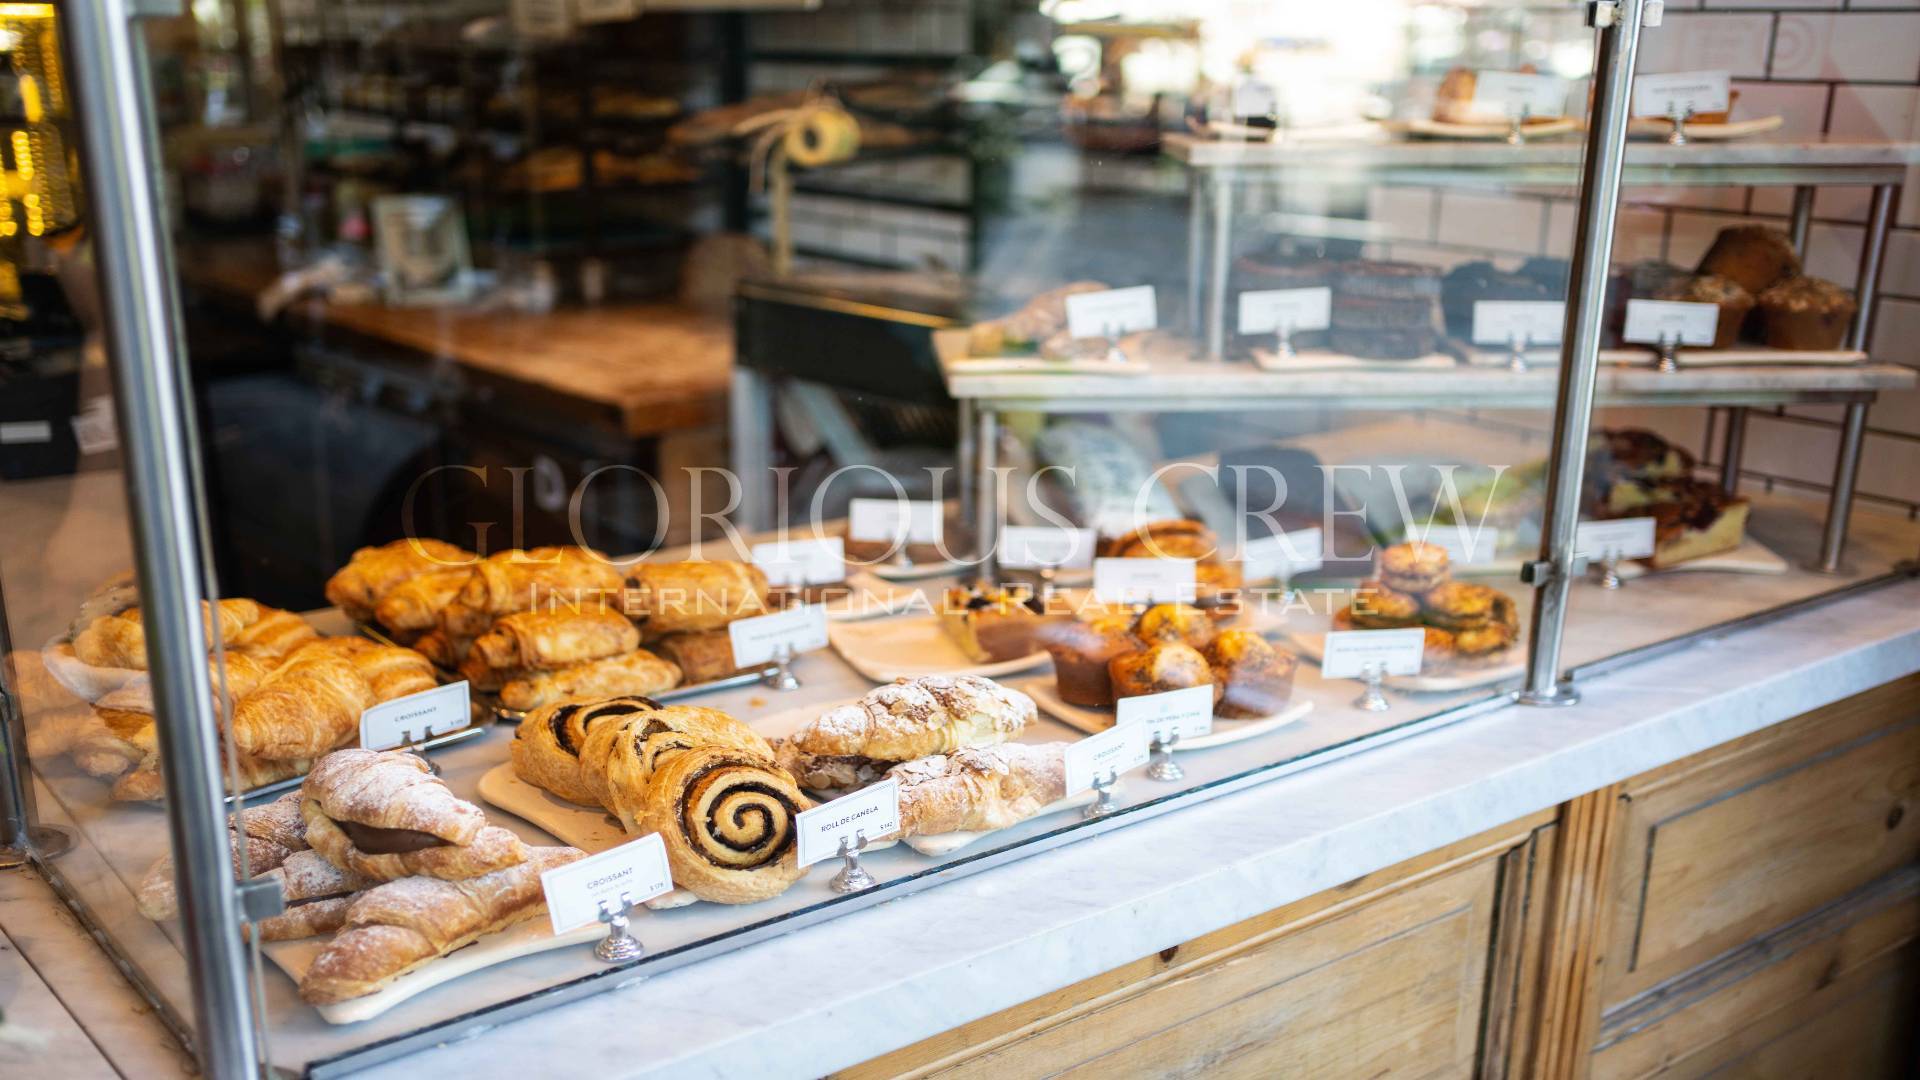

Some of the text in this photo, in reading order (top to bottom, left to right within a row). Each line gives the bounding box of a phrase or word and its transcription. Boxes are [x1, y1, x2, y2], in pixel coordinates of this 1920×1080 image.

[394, 706, 437, 723] CROISSANT
[821, 806, 879, 832] ROLL DE CANELA
[587, 867, 633, 890] CROISSANT
